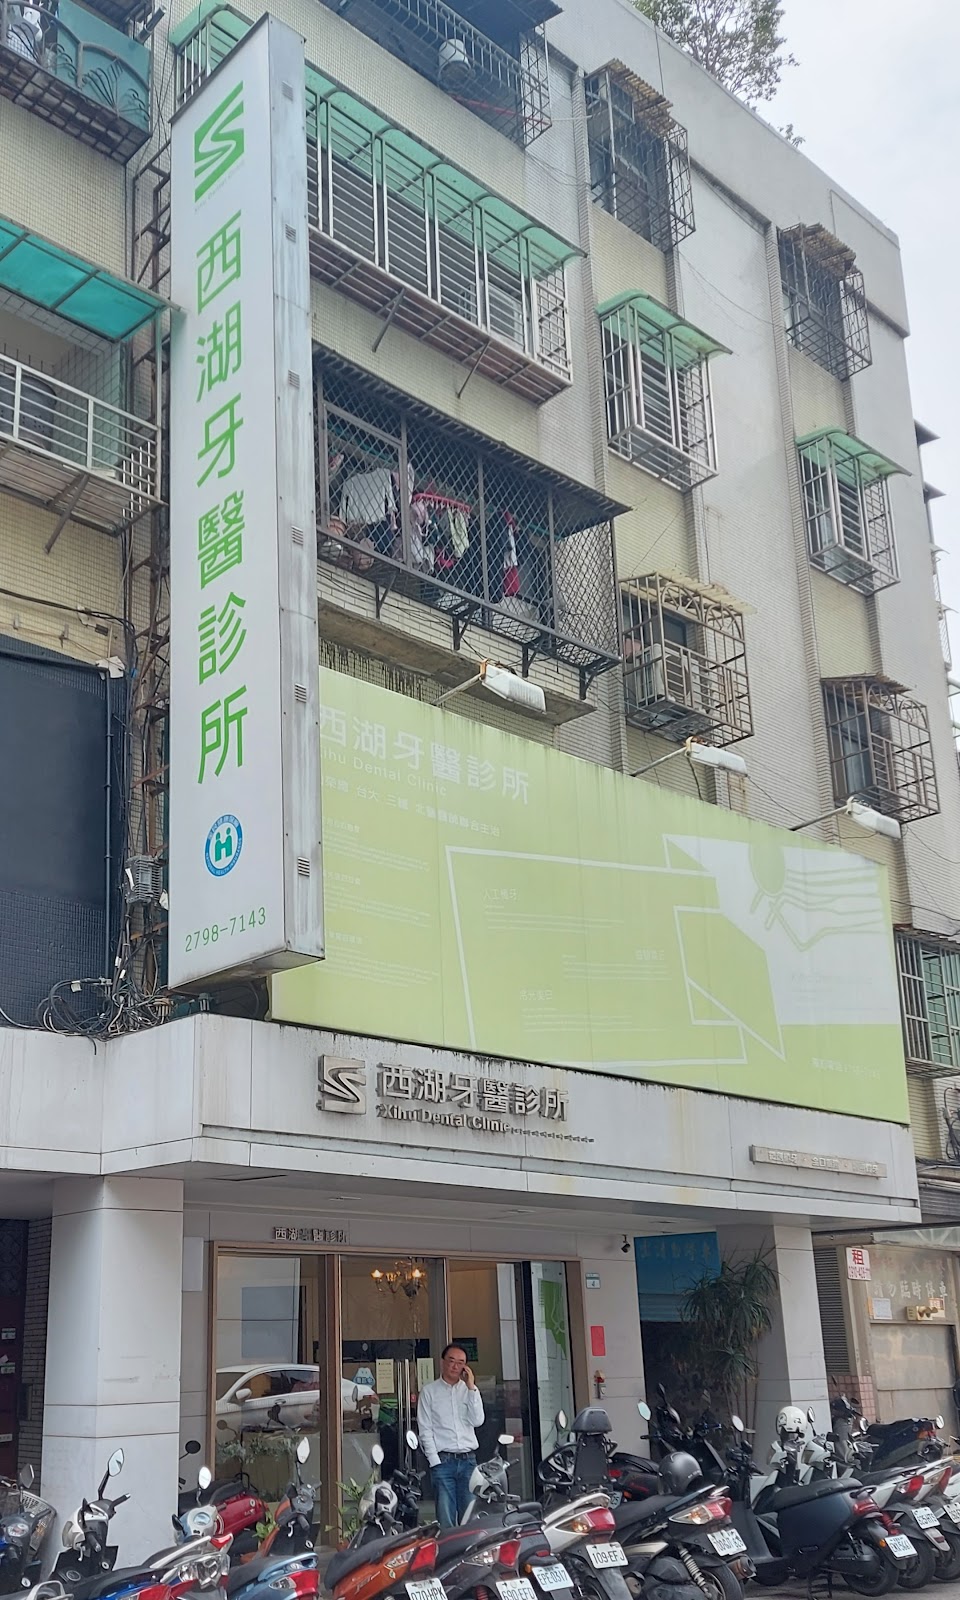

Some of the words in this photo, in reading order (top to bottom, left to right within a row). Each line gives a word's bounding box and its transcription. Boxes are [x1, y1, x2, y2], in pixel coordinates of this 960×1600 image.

[196, 210, 248, 785] 西湖牙醫診所
[320, 704, 530, 805] 西湖牙醫診所
[320, 744, 346, 765] ihu
[353, 757, 400, 781] Dental
[407, 773, 447, 796] Clinic
[185, 906, 267, 953] 2798-7143
[380, 1102, 417, 1121] Xihu
[421, 1107, 468, 1127] Dental
[472, 1115, 511, 1132] Clinic
[381, 1063, 569, 1121] 西湖牙醫診所
[851, 1249, 865, 1265] 租
